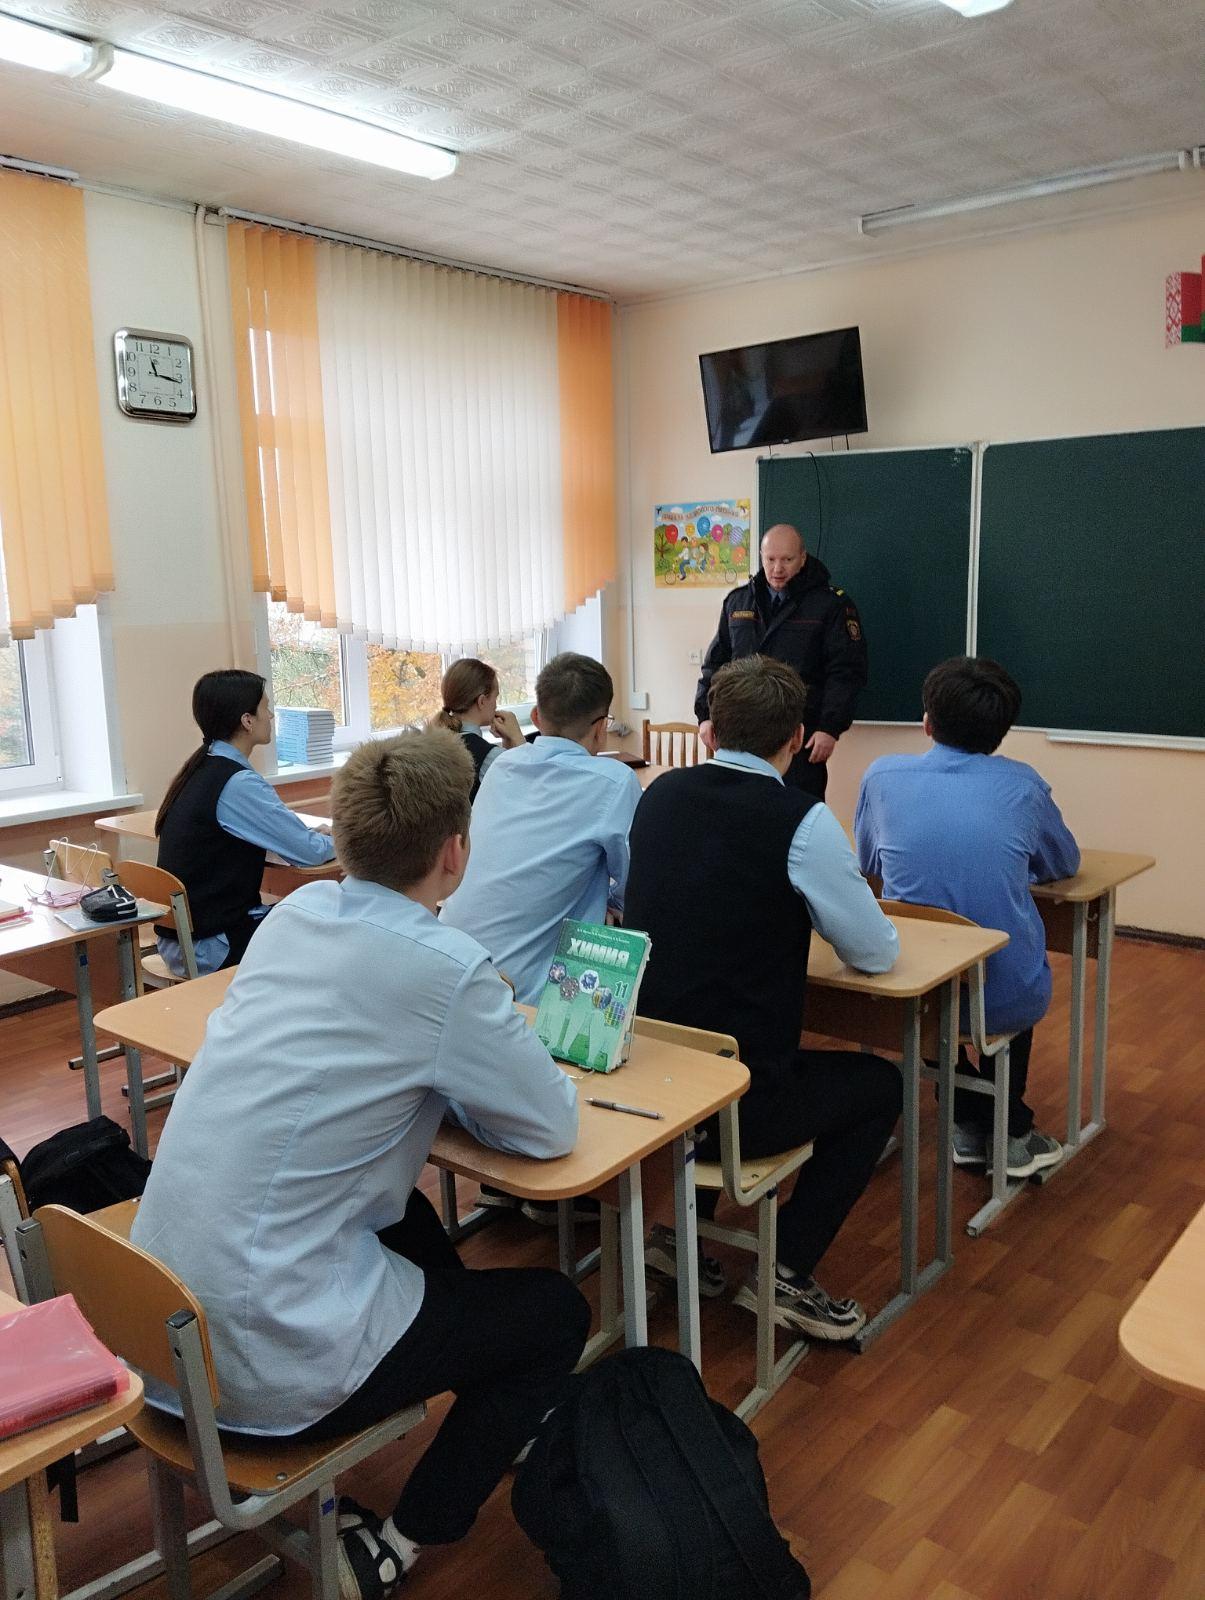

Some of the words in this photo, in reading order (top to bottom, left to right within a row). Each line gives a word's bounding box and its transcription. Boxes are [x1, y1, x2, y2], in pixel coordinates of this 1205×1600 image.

[136, 342, 144, 352] 11
[149, 344, 160, 354] 12
[126, 352, 136, 361] 10
[176, 359, 182, 368] 2
[128, 367, 136, 377] 9
[129, 382, 137, 392] 8
[139, 394, 146, 404] 7
[176, 389, 184, 399] 4
[154, 396, 162, 406] 6
[168, 397, 177, 408] 5
[567, 937, 630, 969] ХИМИЯ
[614, 981, 629, 1000] 11
